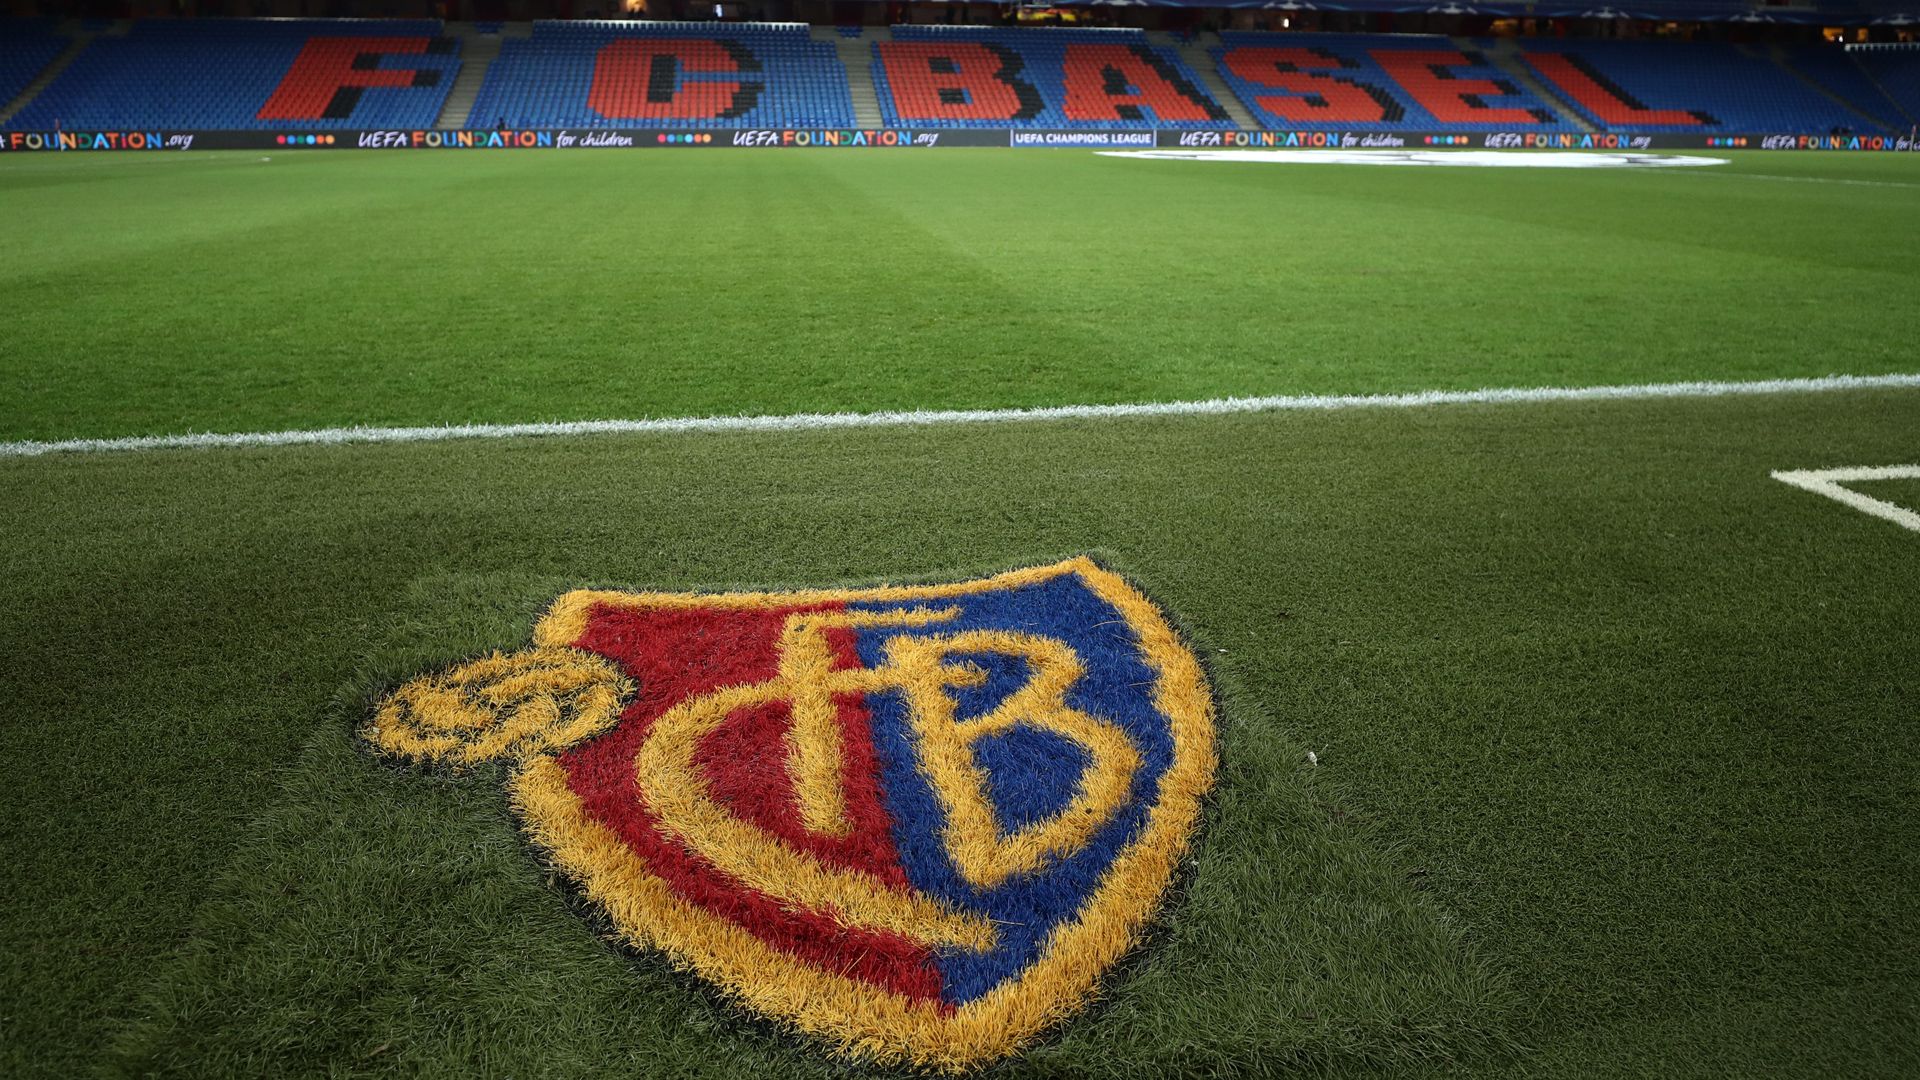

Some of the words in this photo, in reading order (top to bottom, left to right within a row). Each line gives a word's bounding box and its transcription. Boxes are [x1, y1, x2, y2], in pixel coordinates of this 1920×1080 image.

[873, 40, 1716, 125] BASEL
[10, 132, 162, 149] FOUNDATION
[165, 133, 194, 149] .org
[358, 131, 407, 147] UEFA
[412, 131, 551, 147] FOUNDATION
[556, 131, 577, 148] for
[580, 131, 633, 147] children
[733, 130, 779, 146] UEFA
[782, 130, 912, 146] FOUNDATION
[913, 132, 939, 147] .org
[1015, 133, 1045, 144] UEFA
[1046, 133, 1109, 144] CHAMPIONS
[1112, 133, 1152, 144] LEAGUE
[1180, 132, 1221, 147] UEFA
[1225, 132, 1338, 147] FOUNDATION
[1341, 132, 1360, 149] for
[1361, 132, 1404, 147] children
[1484, 133, 1522, 147] UEFA
[1525, 133, 1630, 148] FOUNDATION
[1631, 135, 1652, 149] .org
[1762, 135, 1796, 149] UEFA
[1799, 135, 1893, 149] FOUNDATION
